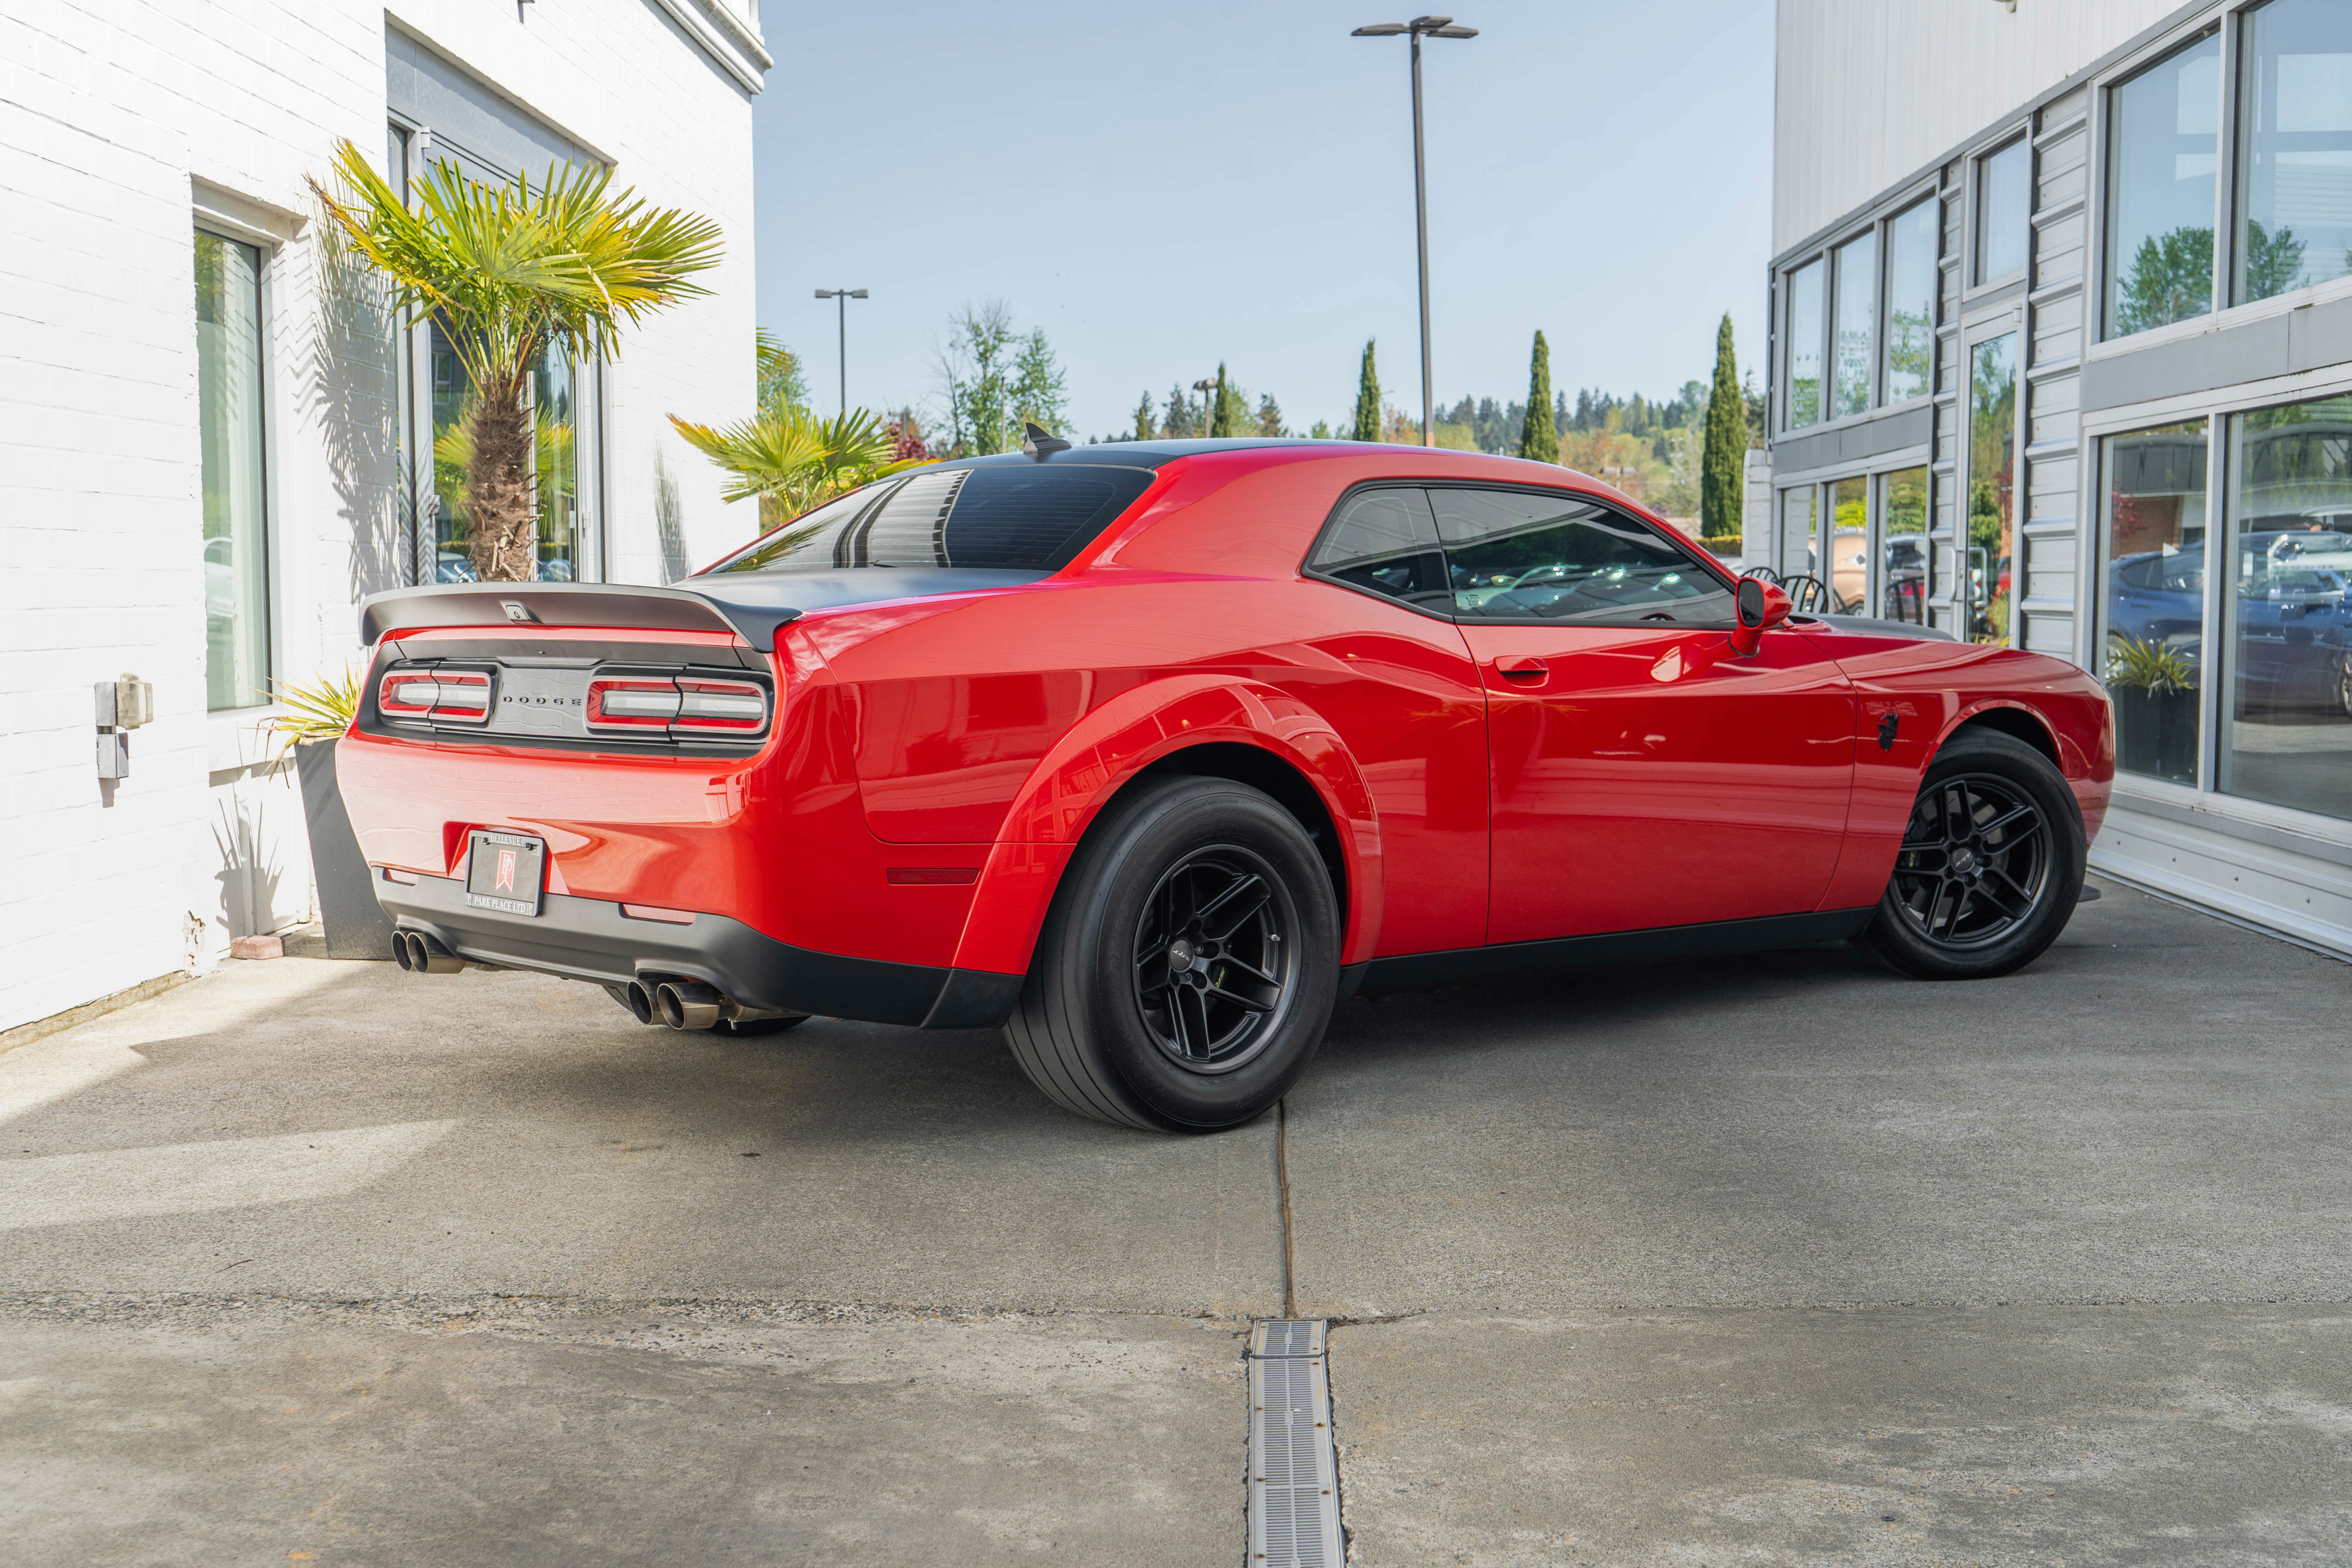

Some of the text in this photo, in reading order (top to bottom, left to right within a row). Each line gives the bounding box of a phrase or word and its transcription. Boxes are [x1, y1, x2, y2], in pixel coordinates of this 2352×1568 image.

[503, 696, 582, 706] DODGE
[490, 834, 521, 846] BELLEVUE
[474, 896, 526, 913] PARK PLACE LTD
[1172, 950, 1191, 961] SRT
[1215, 967, 1225, 988] SR
